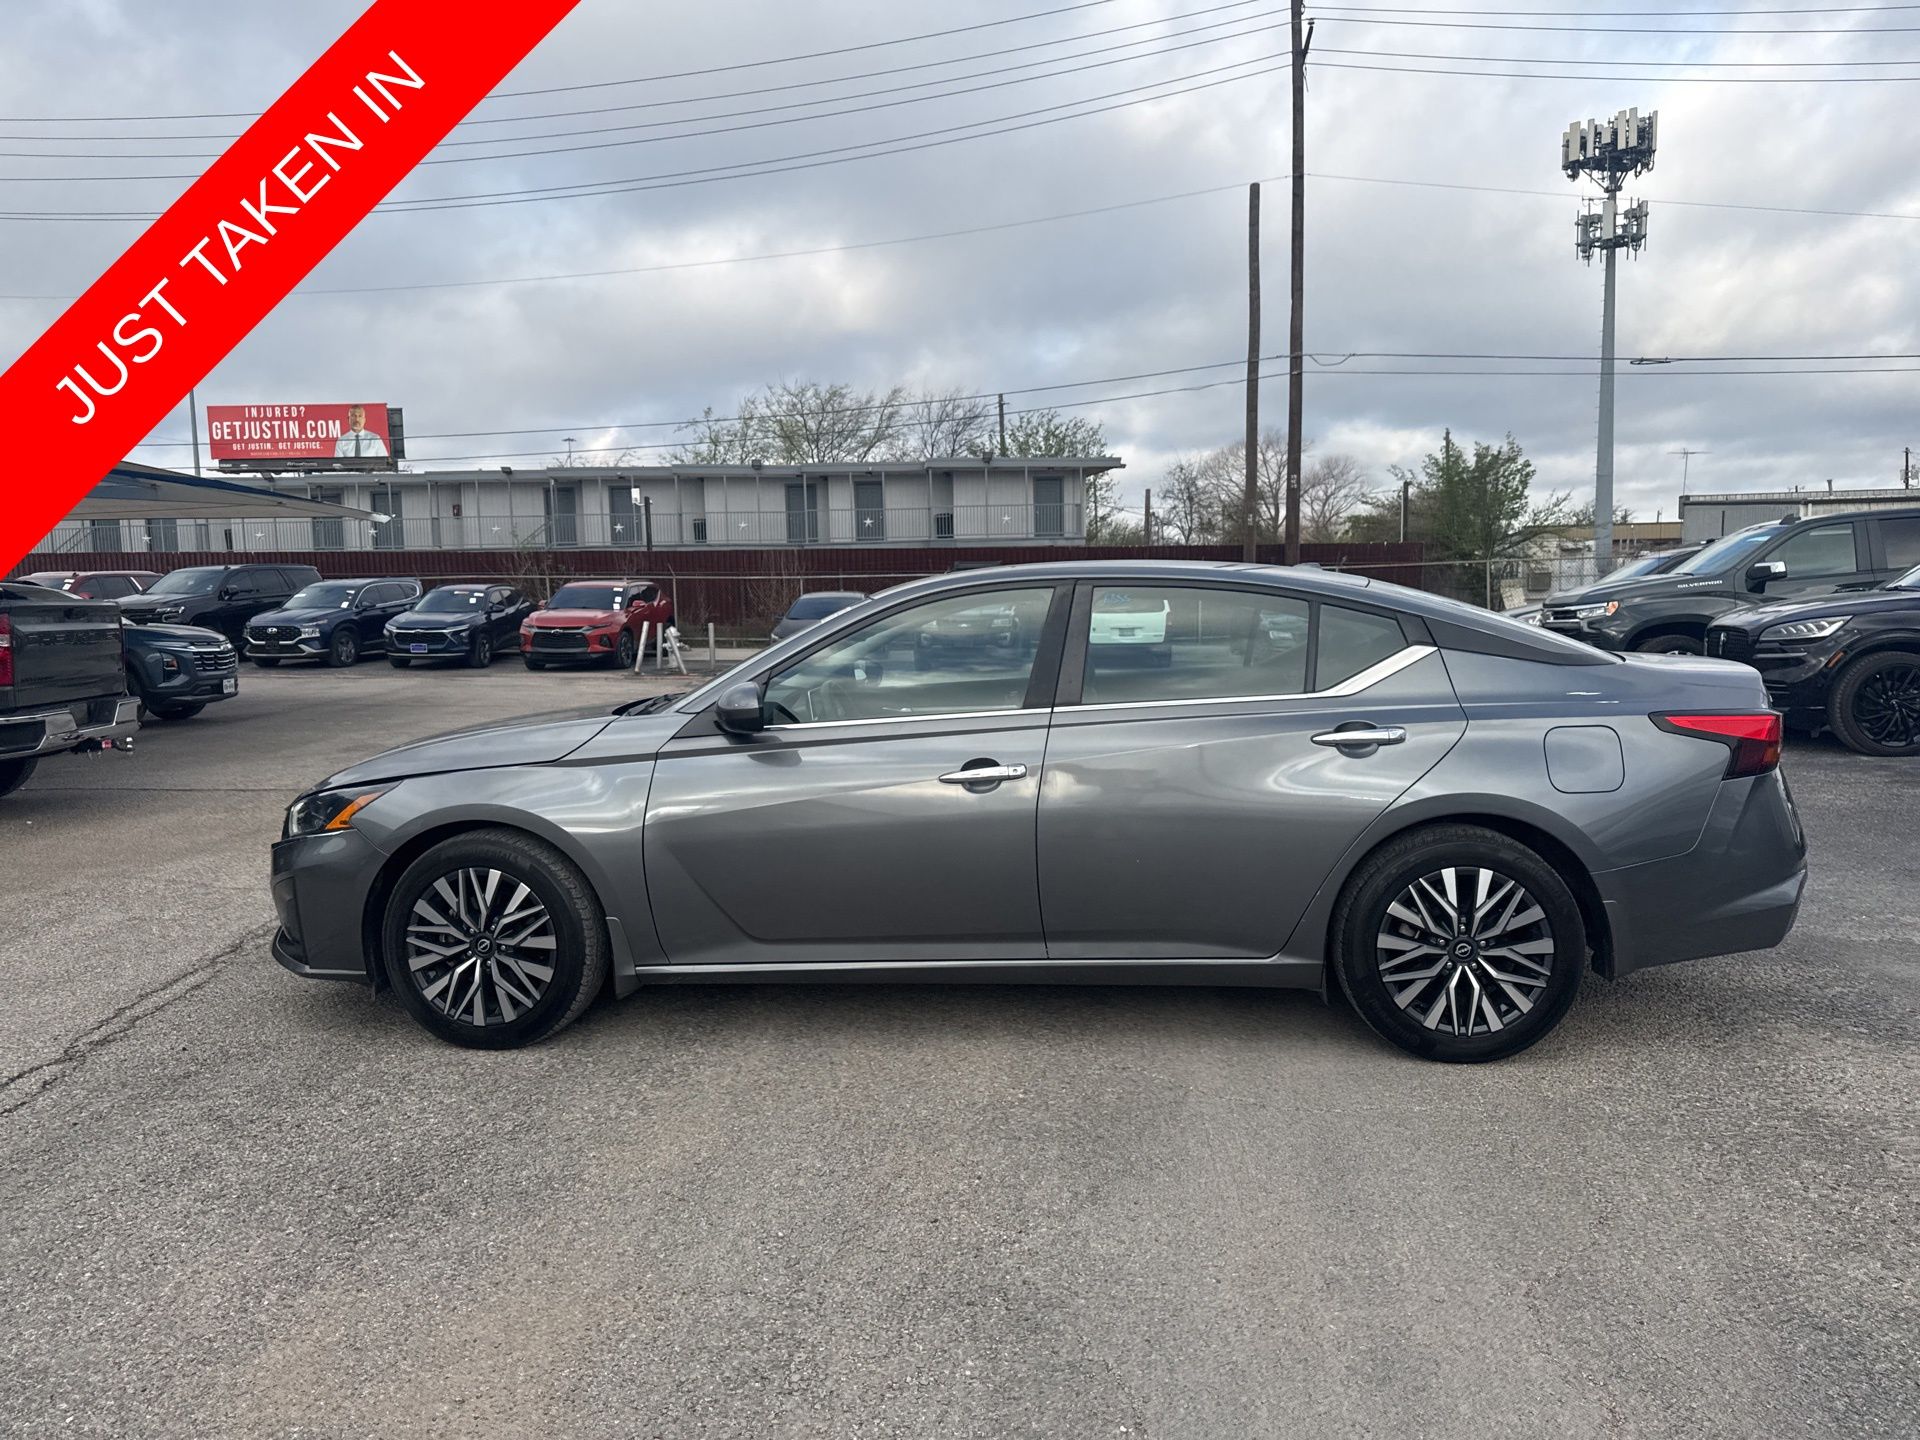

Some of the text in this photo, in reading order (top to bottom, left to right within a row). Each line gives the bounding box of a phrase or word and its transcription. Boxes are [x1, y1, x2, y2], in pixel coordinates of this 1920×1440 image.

[245, 406, 305, 418] INJURED?
[212, 420, 341, 440] GETJUSTIN.COM
[232, 443, 245, 451] GET
[278, 442, 291, 450] GET
